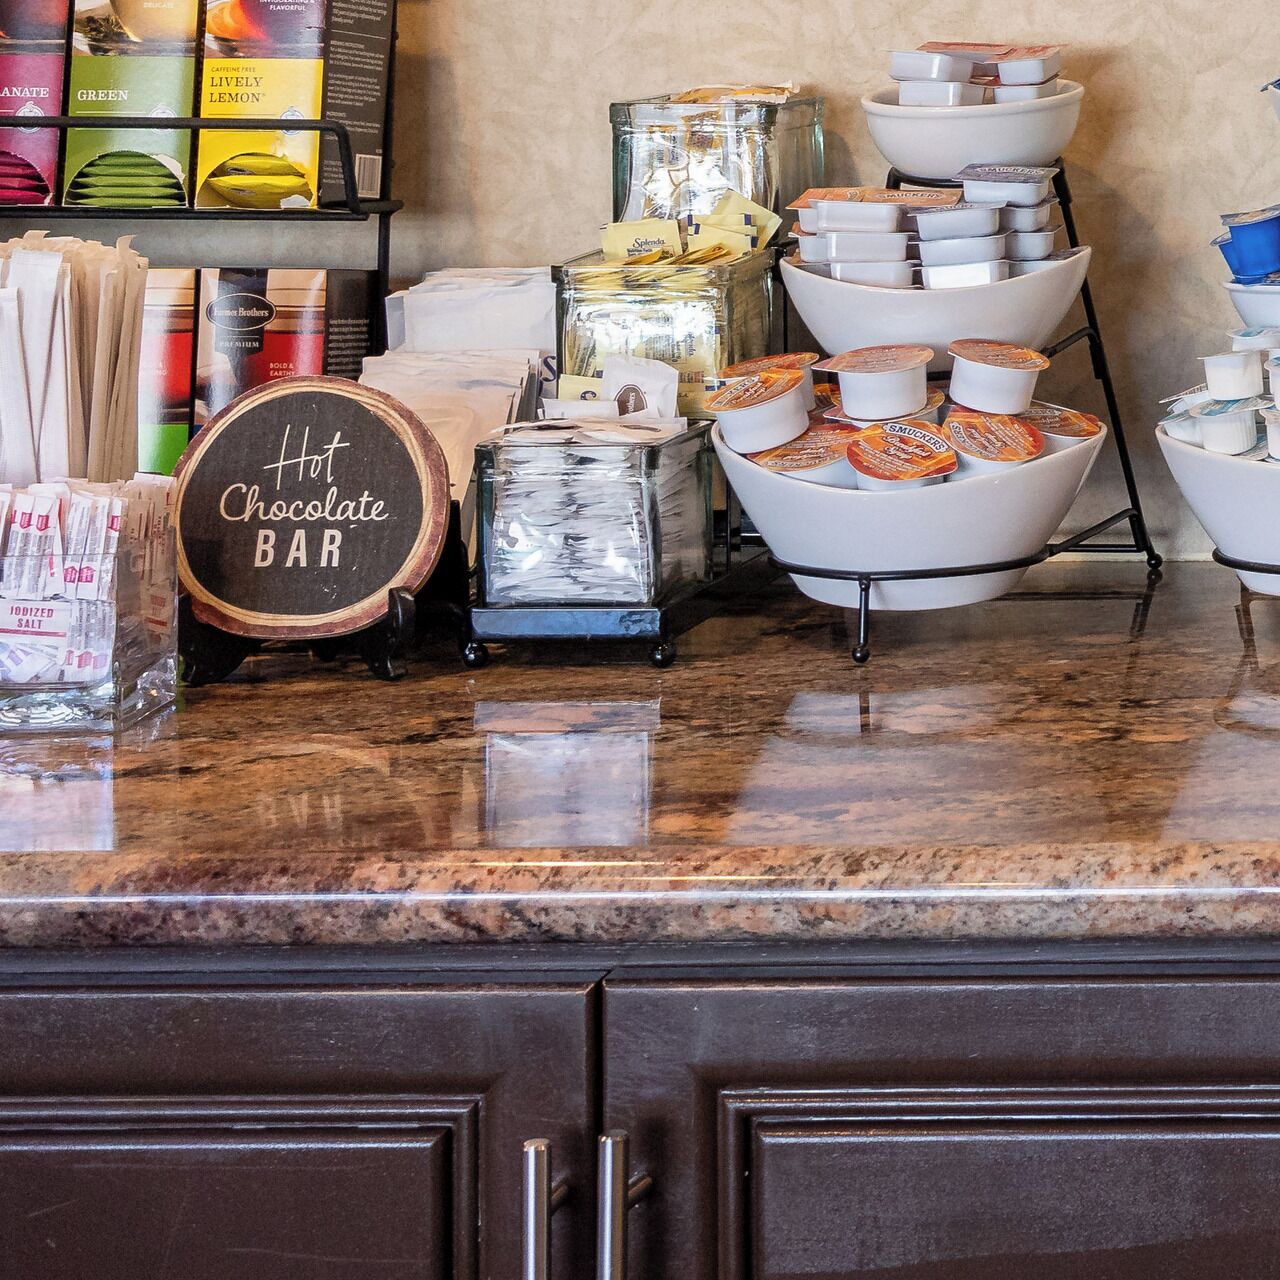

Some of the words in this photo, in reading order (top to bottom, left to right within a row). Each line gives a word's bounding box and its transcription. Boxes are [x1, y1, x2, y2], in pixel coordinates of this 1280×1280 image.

[270, 4, 306, 12] FLAVORFUL
[210, 76, 263, 88] LIVELY
[77, 89, 128, 101] GREEN
[632, 237, 666, 248] Splenda
[238, 308, 269, 318] Brothers
[219, 340, 260, 348] PREMIUM
[269, 362, 288, 370] BOLD
[288, 362, 294, 370] &
[888, 423, 946, 452] SMUCKERS
[263, 423, 351, 491] Hot
[219, 482, 390, 522] Chocolate
[254, 528, 343, 568] BAR
[10, 605, 55, 618] IODIZED
[17, 618, 43, 630] SALT
